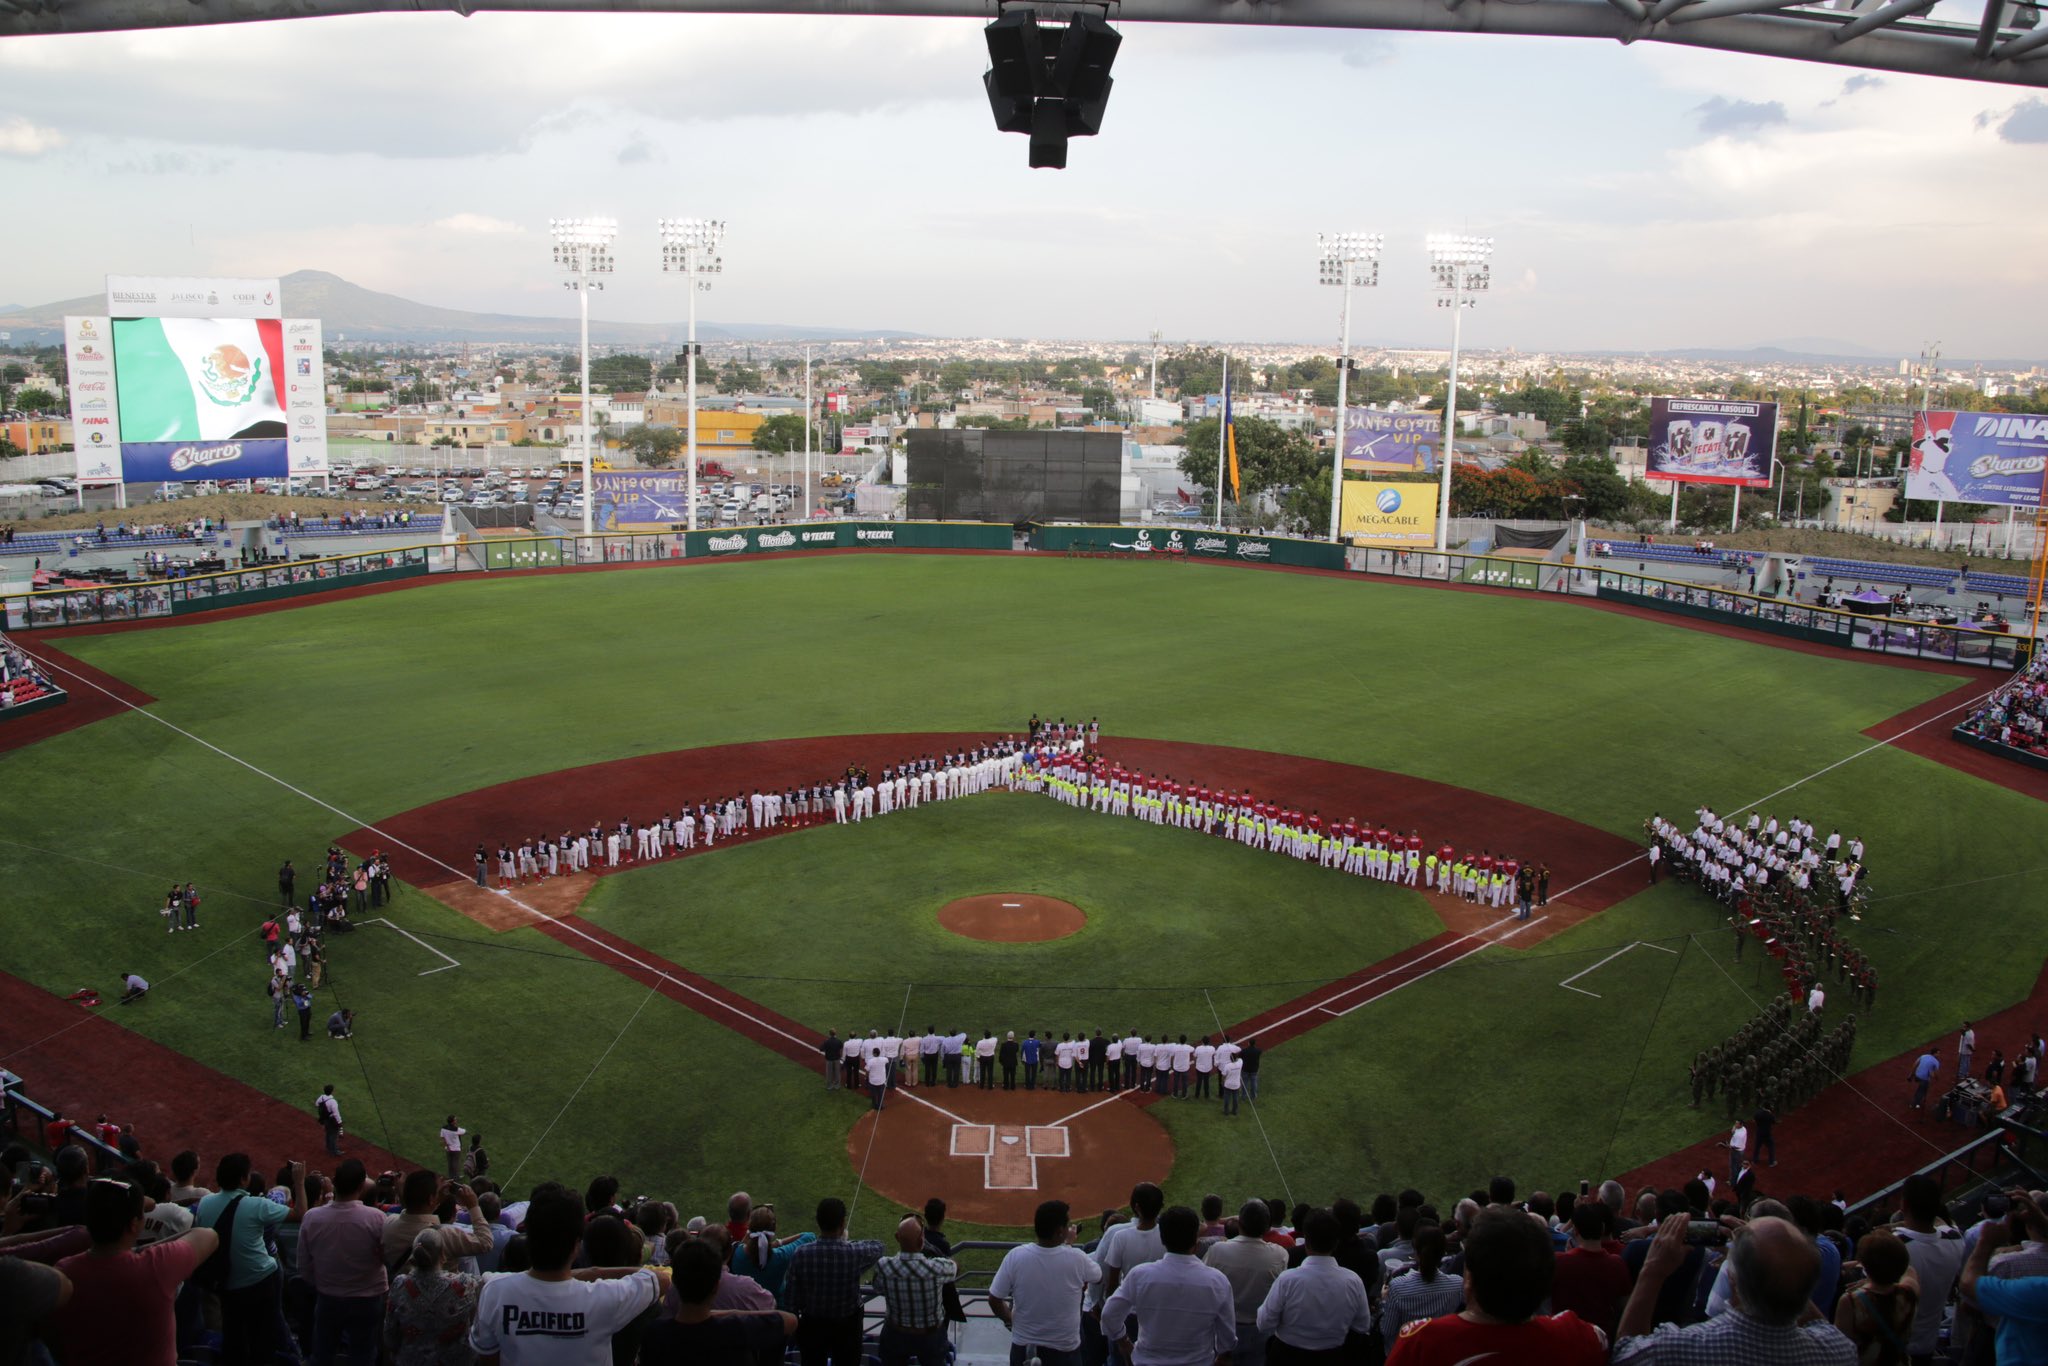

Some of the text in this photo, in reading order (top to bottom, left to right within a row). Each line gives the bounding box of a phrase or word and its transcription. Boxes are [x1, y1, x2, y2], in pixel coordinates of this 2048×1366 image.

[1671, 402, 1755, 414] REFRESCANCIA ABSOLUTA
[82, 417, 109, 425] DINA
[1973, 416, 2048, 440] DINA
[1393, 433, 1422, 444] VIP
[169, 443, 242, 472] Charros
[1968, 454, 2046, 478] Charros
[594, 476, 637, 492] SANTO
[611, 492, 639, 504] VIP
[1356, 514, 1420, 525] MEGACABLE
[810, 531, 836, 541] TECATE
[866, 530, 894, 540] TECATE
[1135, 540, 1152, 548] CHG
[1167, 541, 1183, 549] CHG
[503, 1305, 585, 1335] PACIFICO
